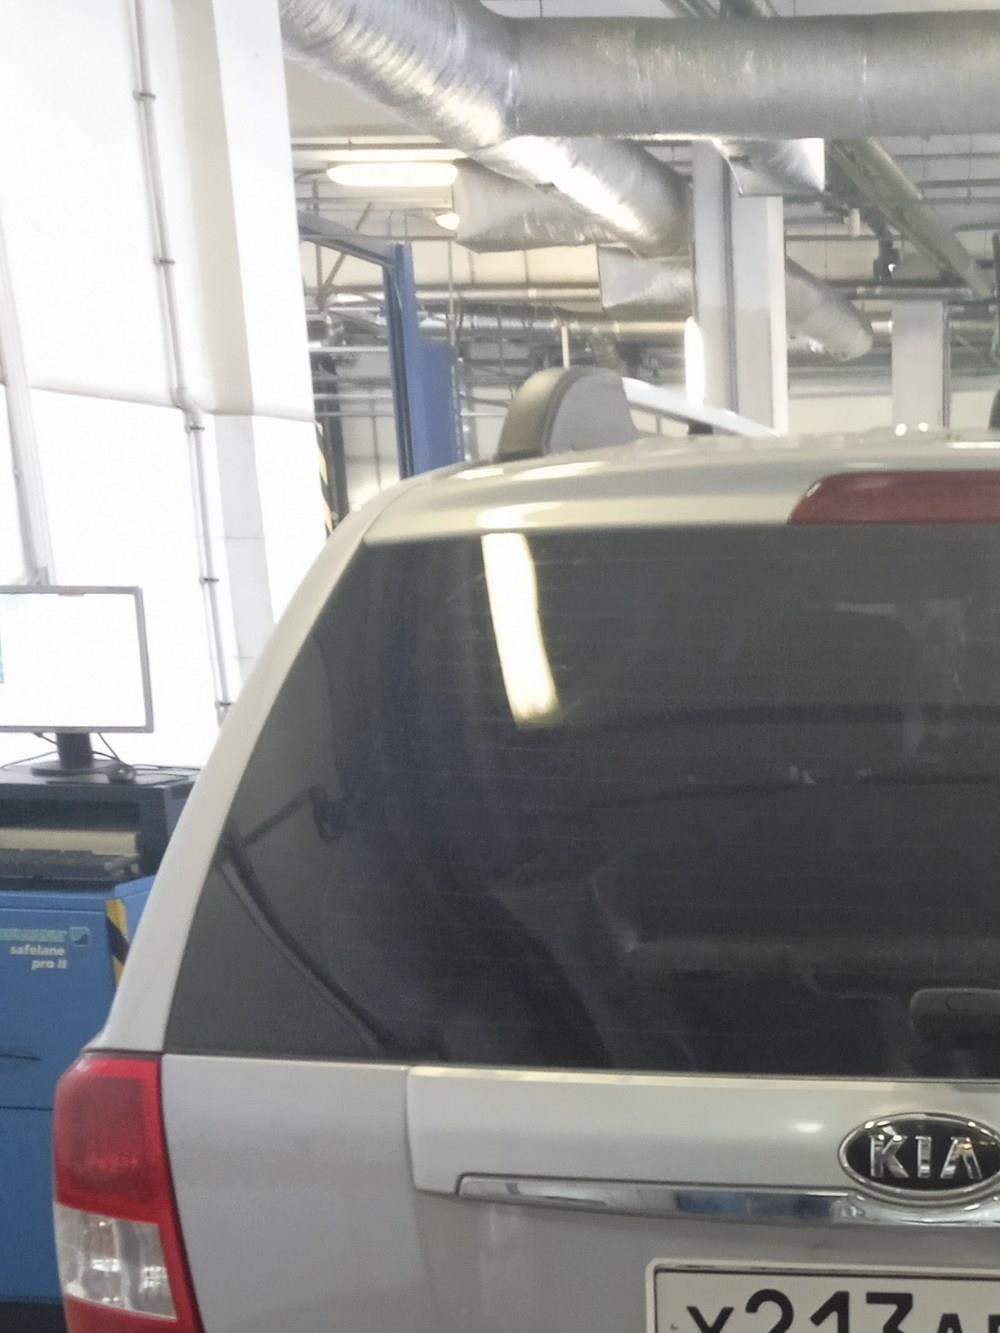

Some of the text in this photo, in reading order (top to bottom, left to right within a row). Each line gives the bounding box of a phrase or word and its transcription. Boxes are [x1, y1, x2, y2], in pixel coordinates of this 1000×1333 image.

[10, 944, 65, 956] safelane
[31, 960, 55, 970] pro
[868, 1135, 983, 1179] KIA
